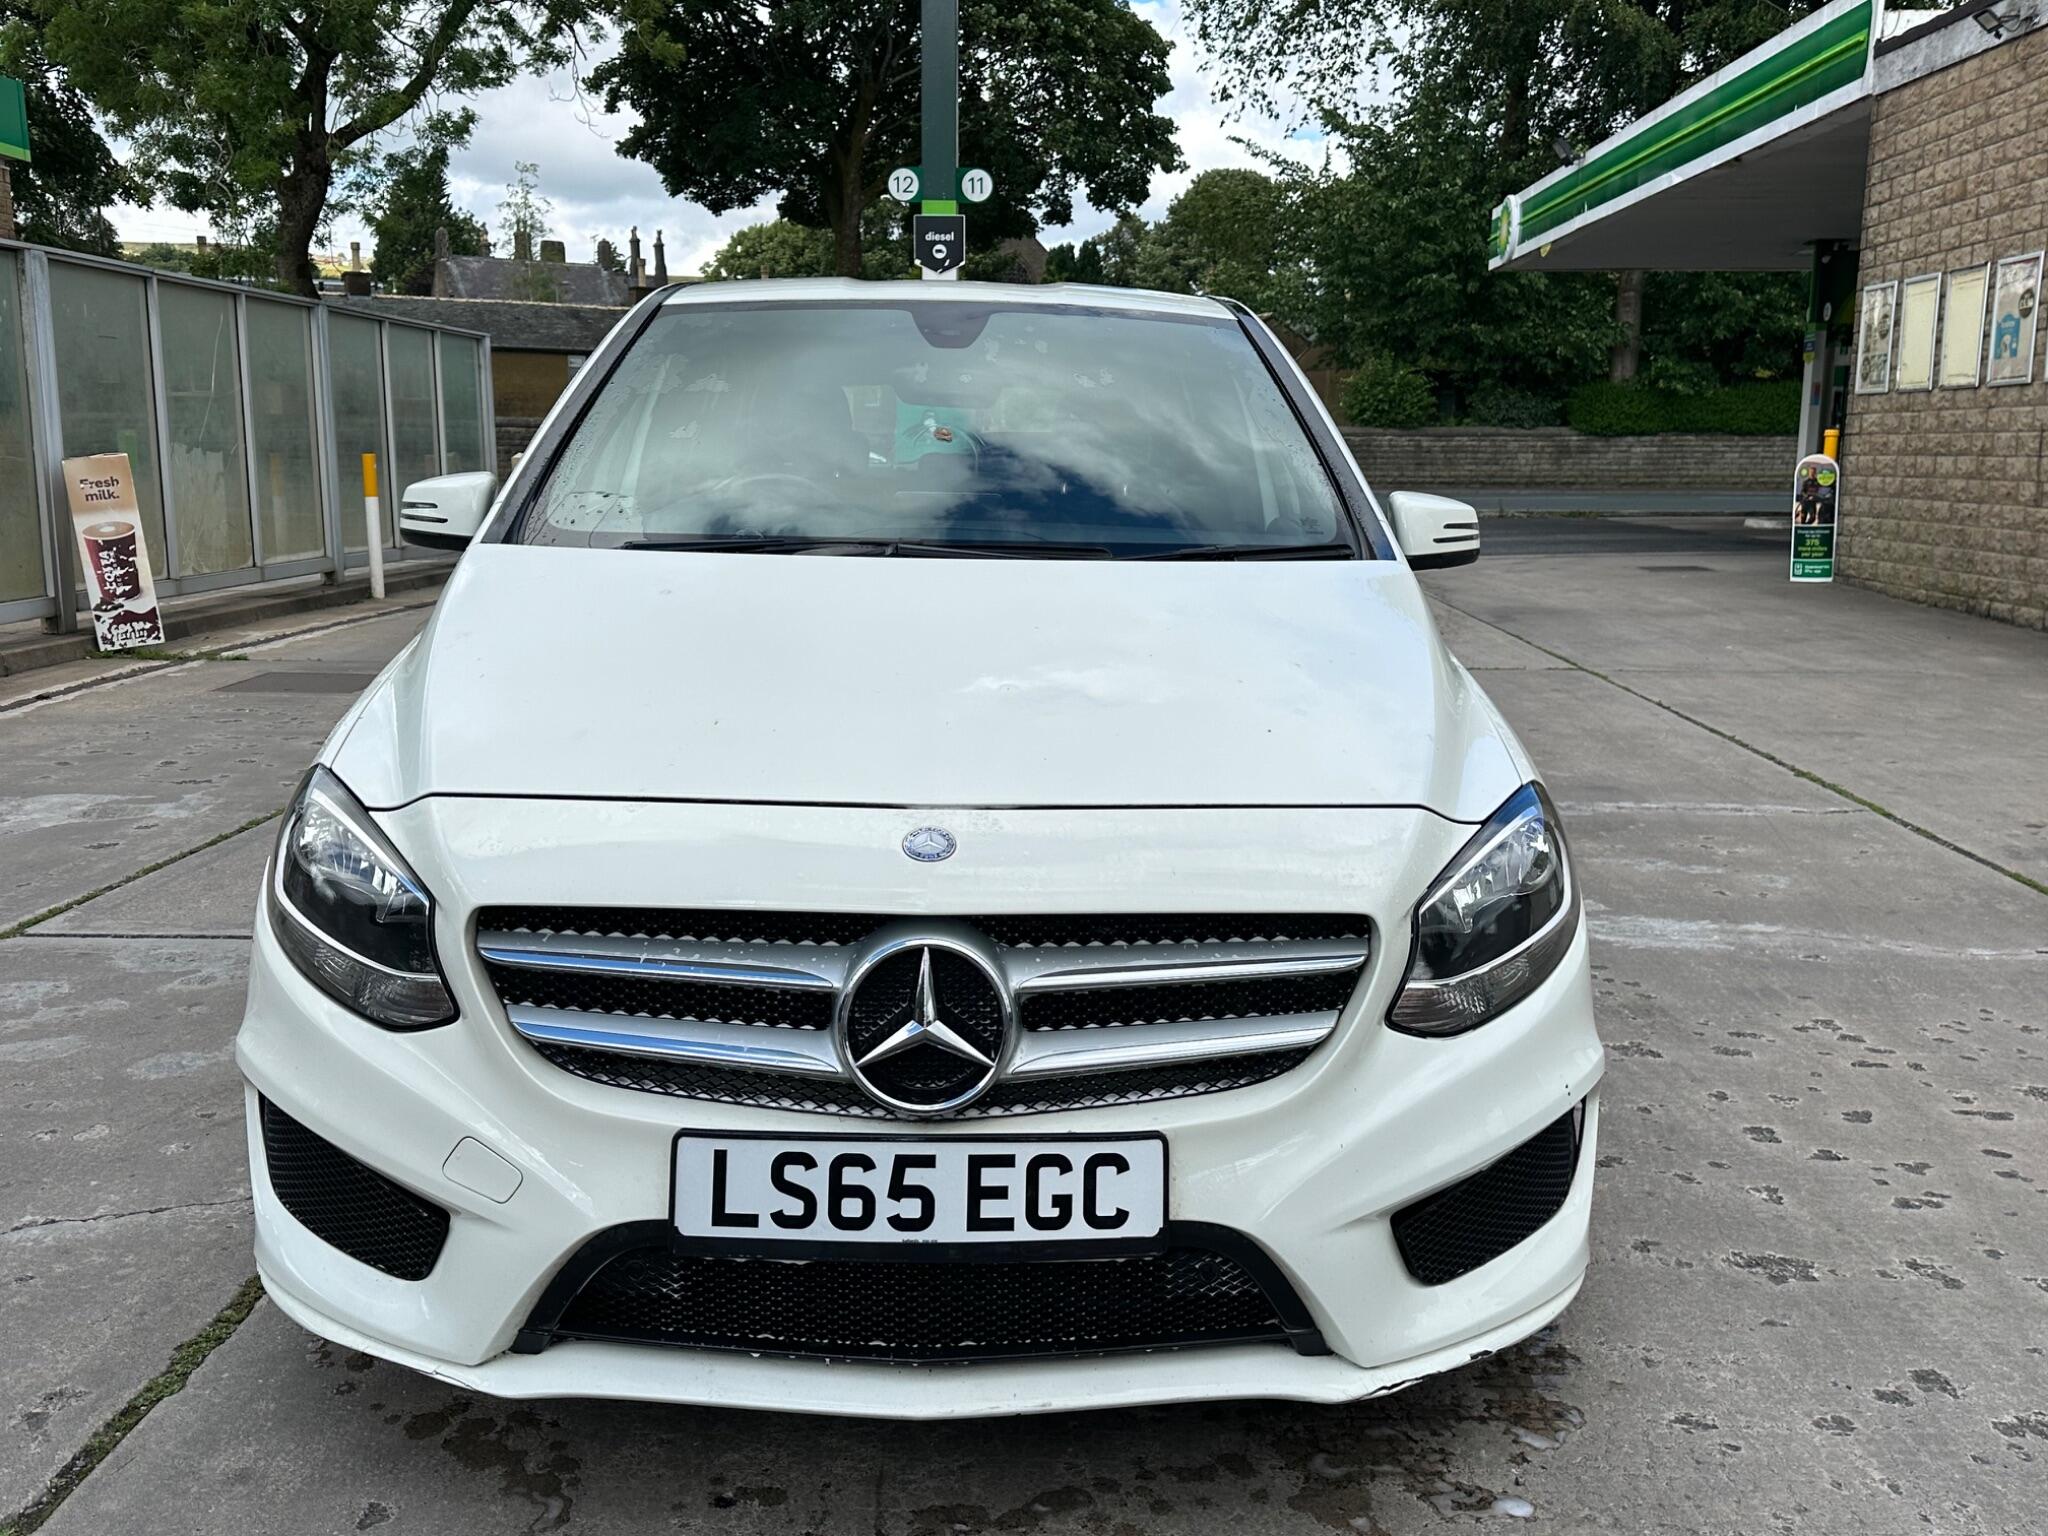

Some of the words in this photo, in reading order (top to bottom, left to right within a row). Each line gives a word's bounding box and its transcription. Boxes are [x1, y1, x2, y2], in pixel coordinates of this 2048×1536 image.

[893, 176, 914, 194] 12
[968, 177, 984, 194] 11
[925, 231, 955, 241] diesel
[79, 476, 119, 490] Fresh
[85, 489, 120, 502] milk.
[711, 1148, 937, 1232] LS65
[966, 1152, 1130, 1232] EGC
